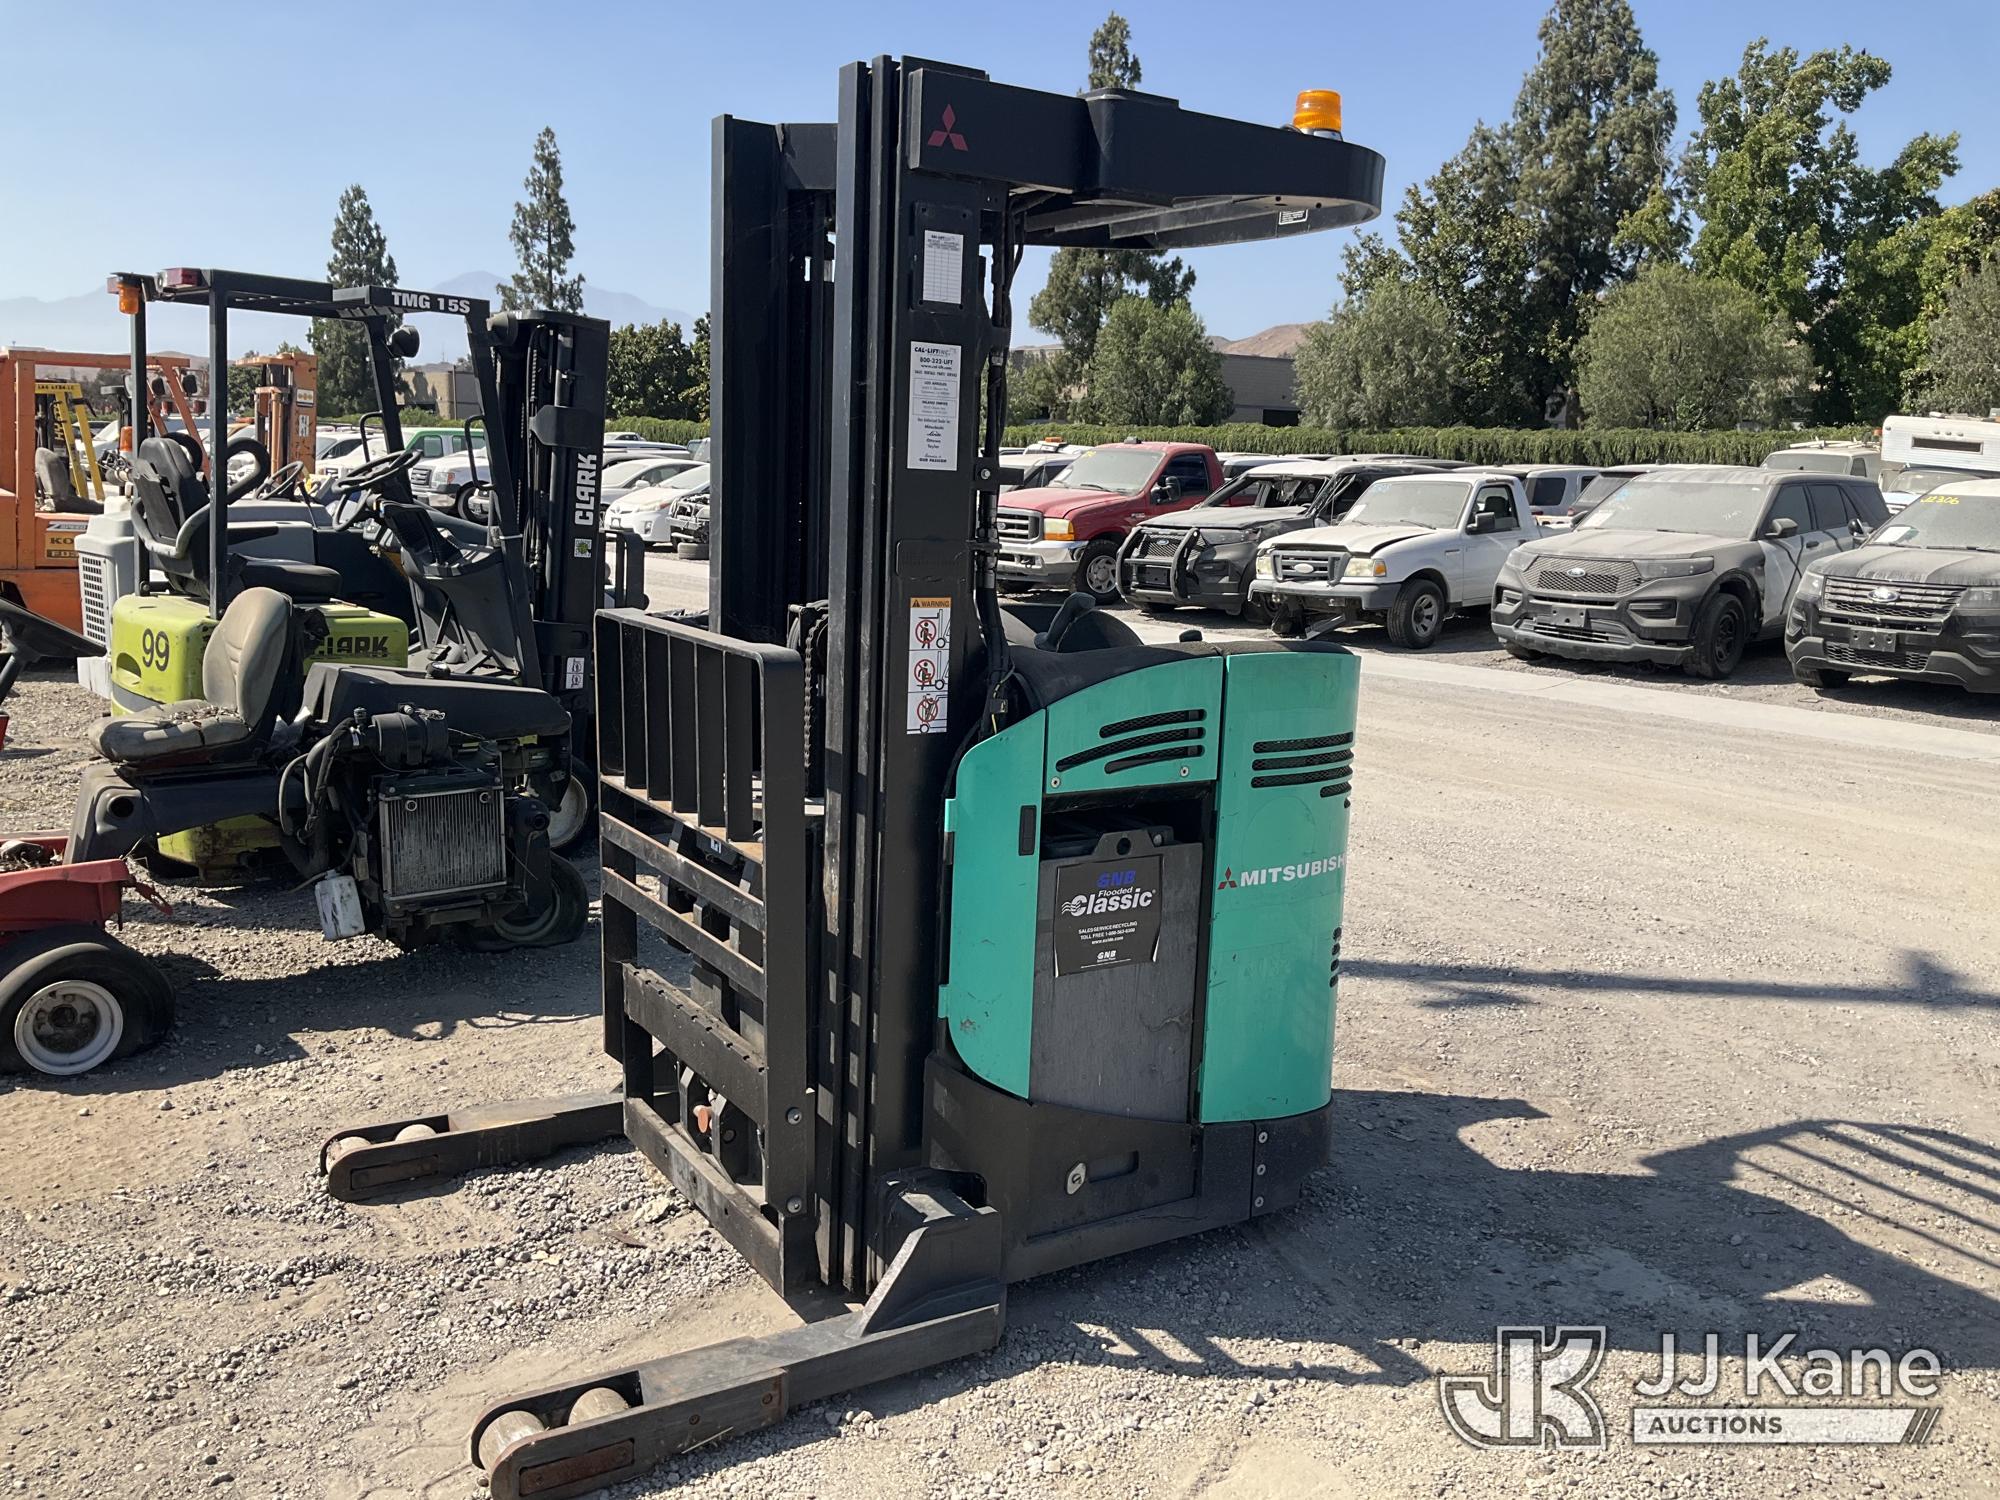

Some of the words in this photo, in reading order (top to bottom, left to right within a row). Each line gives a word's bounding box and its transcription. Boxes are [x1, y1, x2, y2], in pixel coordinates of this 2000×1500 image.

[391, 291, 431, 309] TMG
[437, 297, 471, 314] 15S
[914, 346, 939, 354] CAL-LIFT
[574, 453, 597, 526] CLARK
[921, 600, 950, 608] WARNING
[142, 628, 170, 672] 99
[1097, 870, 1136, 888] GNB
[1098, 886, 1133, 897] Flooded
[1069, 888, 1153, 917] Classic
[1094, 924, 1112, 932] SERVICE
[1112, 920, 1138, 929] RECYCLING
[1097, 950, 1117, 959] GNB
